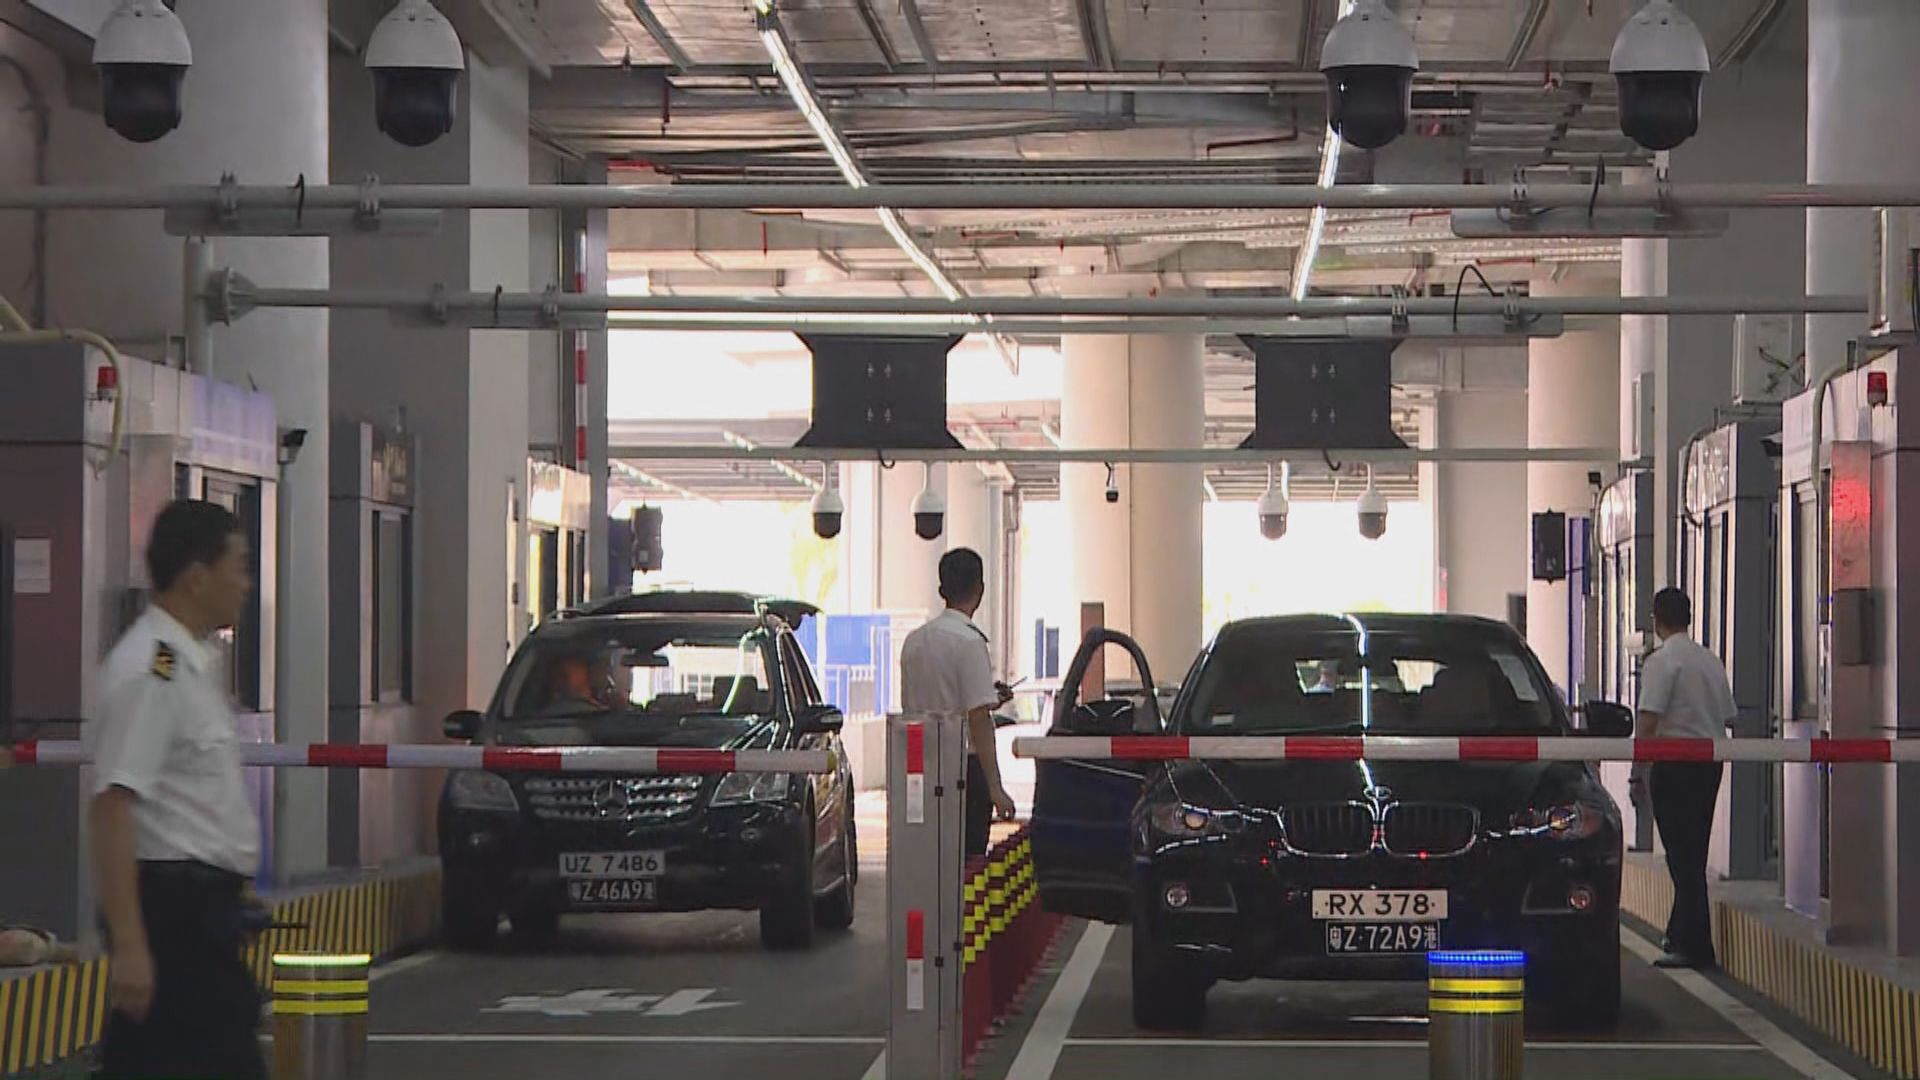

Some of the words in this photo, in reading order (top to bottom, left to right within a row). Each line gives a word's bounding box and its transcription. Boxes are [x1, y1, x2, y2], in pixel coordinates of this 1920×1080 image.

[565, 855, 592, 873] UZ
[601, 855, 658, 872] 7486
[1329, 894, 1365, 915] RX
[1375, 894, 1429, 915] 378
